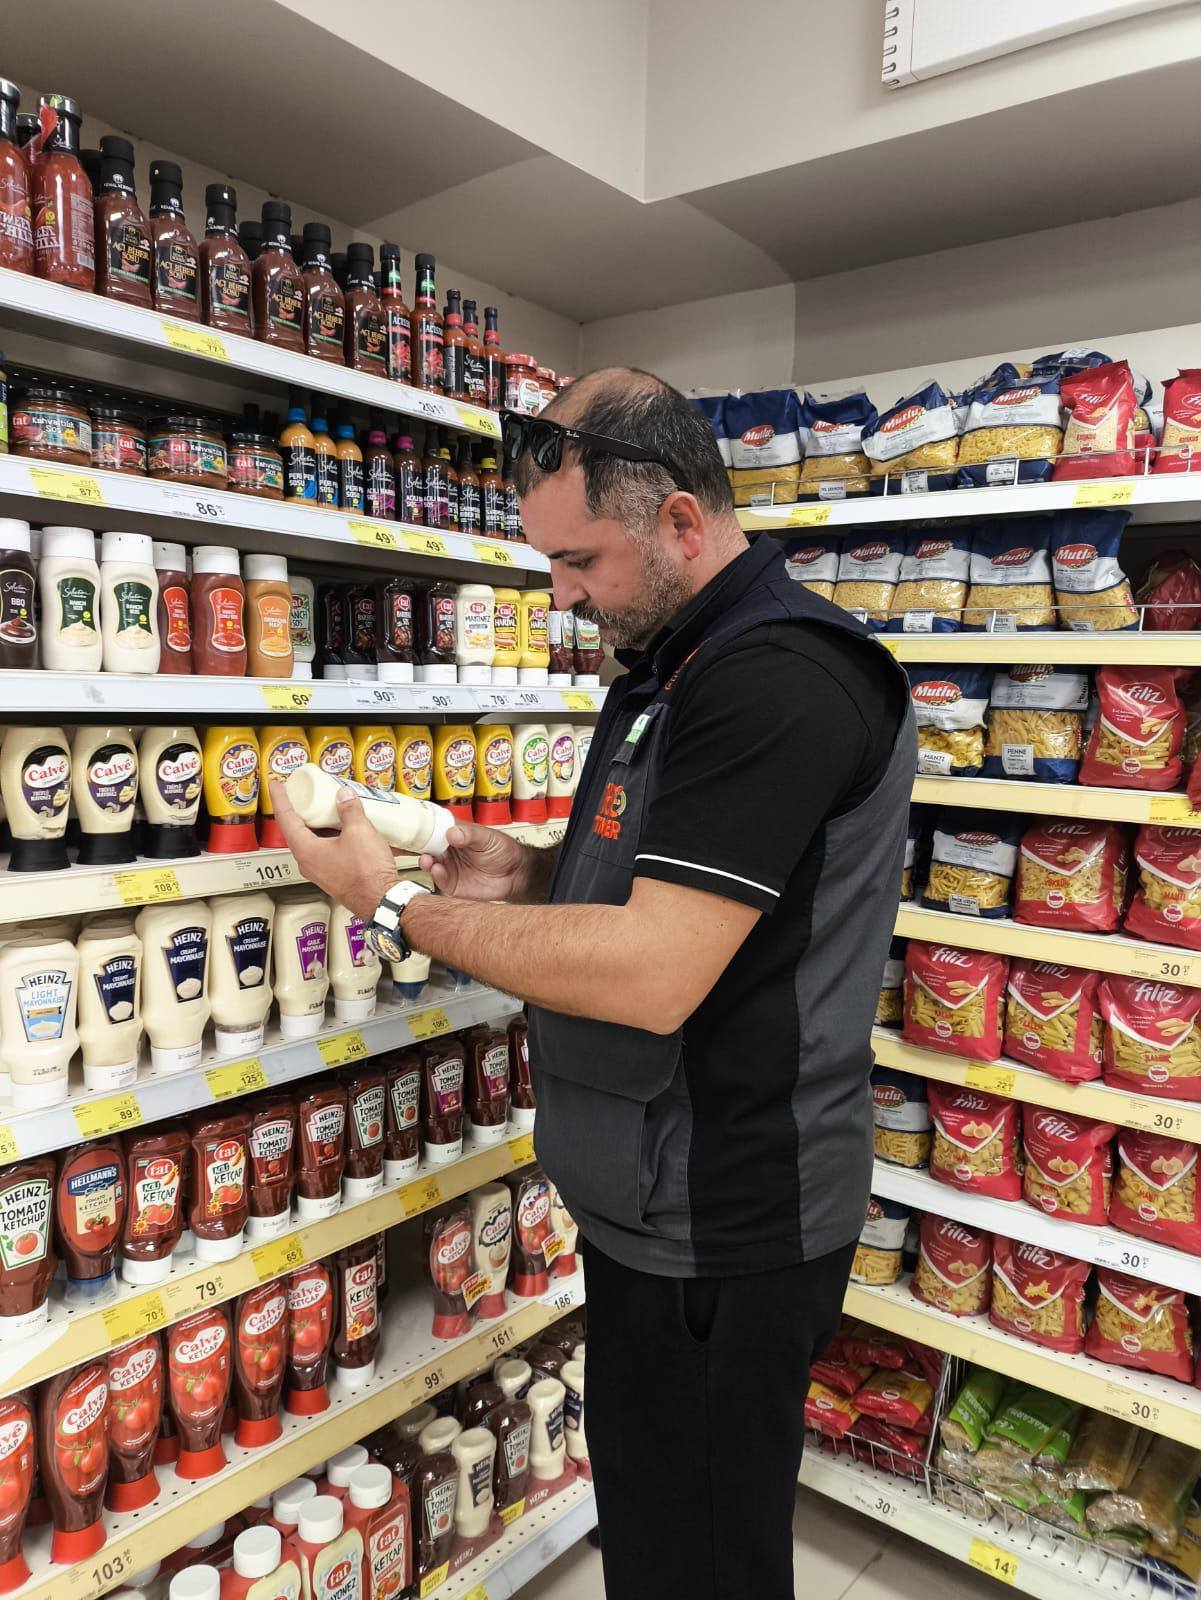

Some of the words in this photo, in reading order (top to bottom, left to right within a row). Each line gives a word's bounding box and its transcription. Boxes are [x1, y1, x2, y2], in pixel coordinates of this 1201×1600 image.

[997, 388, 1039, 404] Mutlu
[12, 416, 28, 426] tat
[883, 408, 924, 430] Mutlu
[46, 424, 62, 433] Sos
[743, 427, 772, 444] Mutlu
[119, 438, 135, 449] tat
[170, 443, 188, 452] tat
[236, 459, 253, 467] tat
[195, 502, 218, 517] 86
[375, 531, 390, 544] 49
[426, 540, 441, 552] 49
[852, 544, 888, 557] Mutlu
[494, 551, 507, 562] 49
[1056, 549, 1093, 562] Mutlu
[11, 597, 26, 608] BBQ
[470, 602, 485, 612] tat
[500, 606, 512, 616] tat
[534, 609, 545, 619] tat
[373, 690, 391, 702] 90
[491, 694, 506, 706] 79
[519, 692, 539, 704] 100
[914, 685, 957, 700] Mutlu
[1125, 686, 1165, 704] filiz
[432, 694, 448, 707] 90
[407, 747, 432, 762] Calvé
[449, 745, 475, 761] Calvé
[489, 745, 512, 760] Calvé
[527, 743, 548, 758] Calvé
[162, 756, 199, 777] Calvé
[226, 754, 256, 770] Calvé
[274, 751, 305, 767] Calvé
[324, 752, 350, 768] Calvé
[369, 752, 393, 767] Calvé
[28, 760, 67, 782] Calvé
[93, 758, 132, 781] Calvé
[256, 864, 283, 882] 101
[154, 881, 173, 895] 108
[237, 921, 265, 935] HEINZ
[305, 925, 325, 937] HEINZ
[173, 932, 202, 946] HEINZ
[242, 937, 260, 945] CREAMY
[179, 948, 198, 957] CREAMY
[233, 941, 267, 953] MAYONNAISE
[170, 952, 205, 966] MAYONNAISE
[930, 946, 975, 970] filiz
[106, 960, 134, 974] HEINZ
[1159, 962, 1181, 977] 30
[29, 975, 62, 989] HEINZ
[102, 979, 137, 993] MAYONNAISE
[31, 988, 59, 1001] LIGHT
[1134, 982, 1184, 1005] filiz
[23, 996, 66, 1009] MAYONNAISE
[347, 1043, 361, 1054] 144
[491, 1050, 507, 1062] HEINZ
[441, 1064, 461, 1077] HEINZ
[241, 1073, 257, 1085] 125
[399, 1074, 420, 1090] HEINZ
[363, 1090, 384, 1104] HEINZ
[951, 1092, 991, 1110] filiz
[119, 1110, 133, 1121] 89
[318, 1111, 340, 1125] HEINZ
[1152, 1113, 1174, 1129] 30
[261, 1127, 287, 1141] HEINZ
[315, 1122, 341, 1136] TOMATO
[1038, 1115, 1080, 1144] filiz
[258, 1138, 288, 1152] TOMATO
[217, 1146, 238, 1160] tat
[149, 1164, 171, 1176] tat
[71, 1166, 118, 1191] HELLMANN'S
[213, 1167, 243, 1189] KETÇAP
[5, 1185, 42, 1207] HEINZ
[142, 1187, 176, 1205] KETÇAP
[0, 1200, 48, 1224] TOMATO
[521, 1199, 547, 1226] Calvé
[3, 1211, 47, 1233] KETCHUP
[484, 1216, 510, 1240] Calvé
[939, 1220, 981, 1252] filiz
[440, 1234, 470, 1260] Calvé
[286, 1252, 298, 1262] 65
[1017, 1240, 1060, 1273] filiz
[1120, 1252, 1141, 1268] 30
[354, 1268, 373, 1283] tat
[196, 1280, 218, 1300] 79
[553, 1292, 572, 1313] 186
[145, 1311, 159, 1323] 70
[248, 1297, 285, 1326] Calvé
[256, 1310, 283, 1334] KETÇAP
[179, 1327, 224, 1356] Calvé
[490, 1330, 511, 1351] 161
[188, 1340, 220, 1363] KETÇAP
[110, 1351, 153, 1383] Calvé
[120, 1364, 152, 1390] KETÇAP
[424, 1372, 441, 1391] 99
[66, 1386, 107, 1427] Calvé
[1130, 1402, 1151, 1419] 30
[433, 1481, 456, 1500] HEINZ
[528, 1488, 549, 1505] HEINZ
[875, 1497, 892, 1515] 30
[377, 1528, 400, 1549] tat
[453, 1545, 475, 1568] HEINZ
[93, 1556, 125, 1587] 103
[993, 1556, 1010, 1575] 14
[328, 1563, 350, 1587] tat
